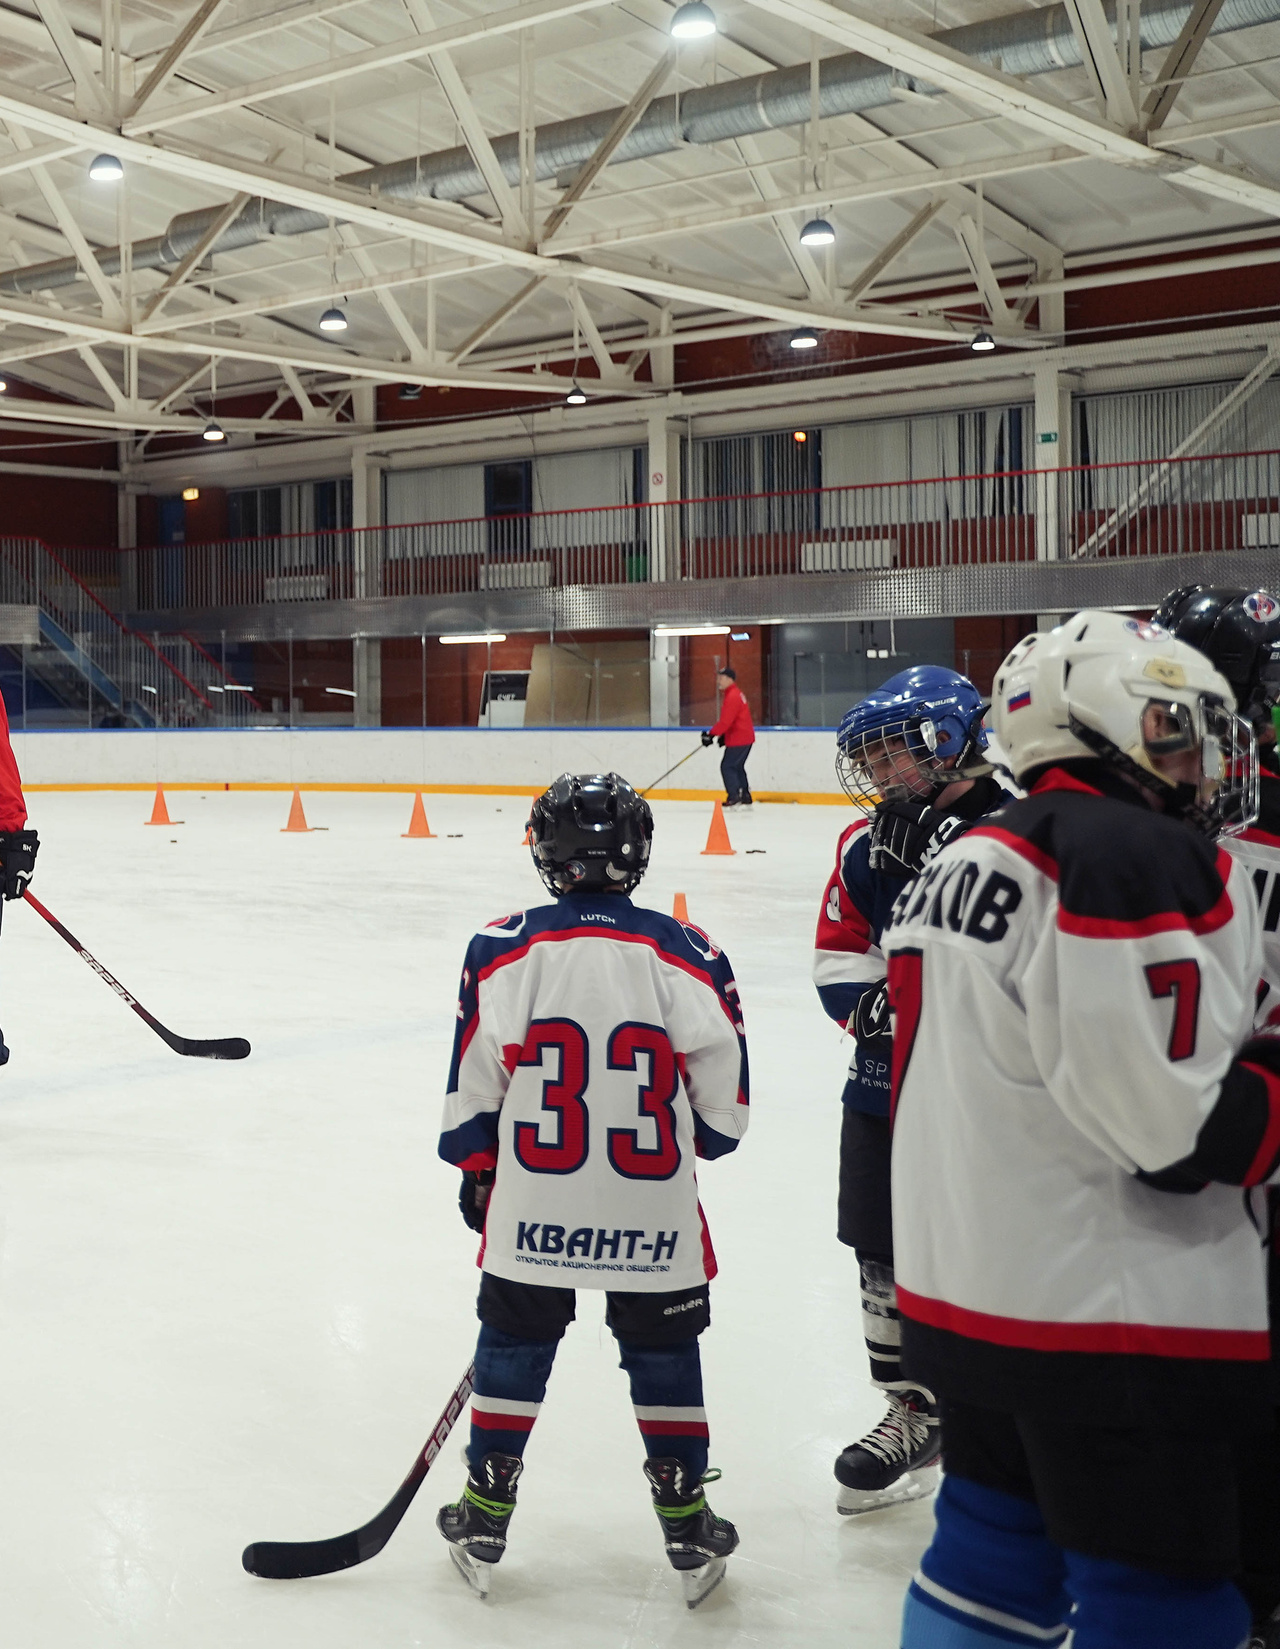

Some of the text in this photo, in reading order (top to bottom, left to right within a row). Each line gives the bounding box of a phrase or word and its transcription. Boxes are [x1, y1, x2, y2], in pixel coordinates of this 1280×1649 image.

[580, 913, 616, 925] LUTCH
[1144, 957, 1202, 1063] 7
[513, 1016, 682, 1181] 33
[516, 1221, 679, 1263] КВАНТ-Н
[515, 1254, 671, 1273] ОТКРЫТОЕ АКЦИОНЕРНОЕ ОБЩЕСТВО
